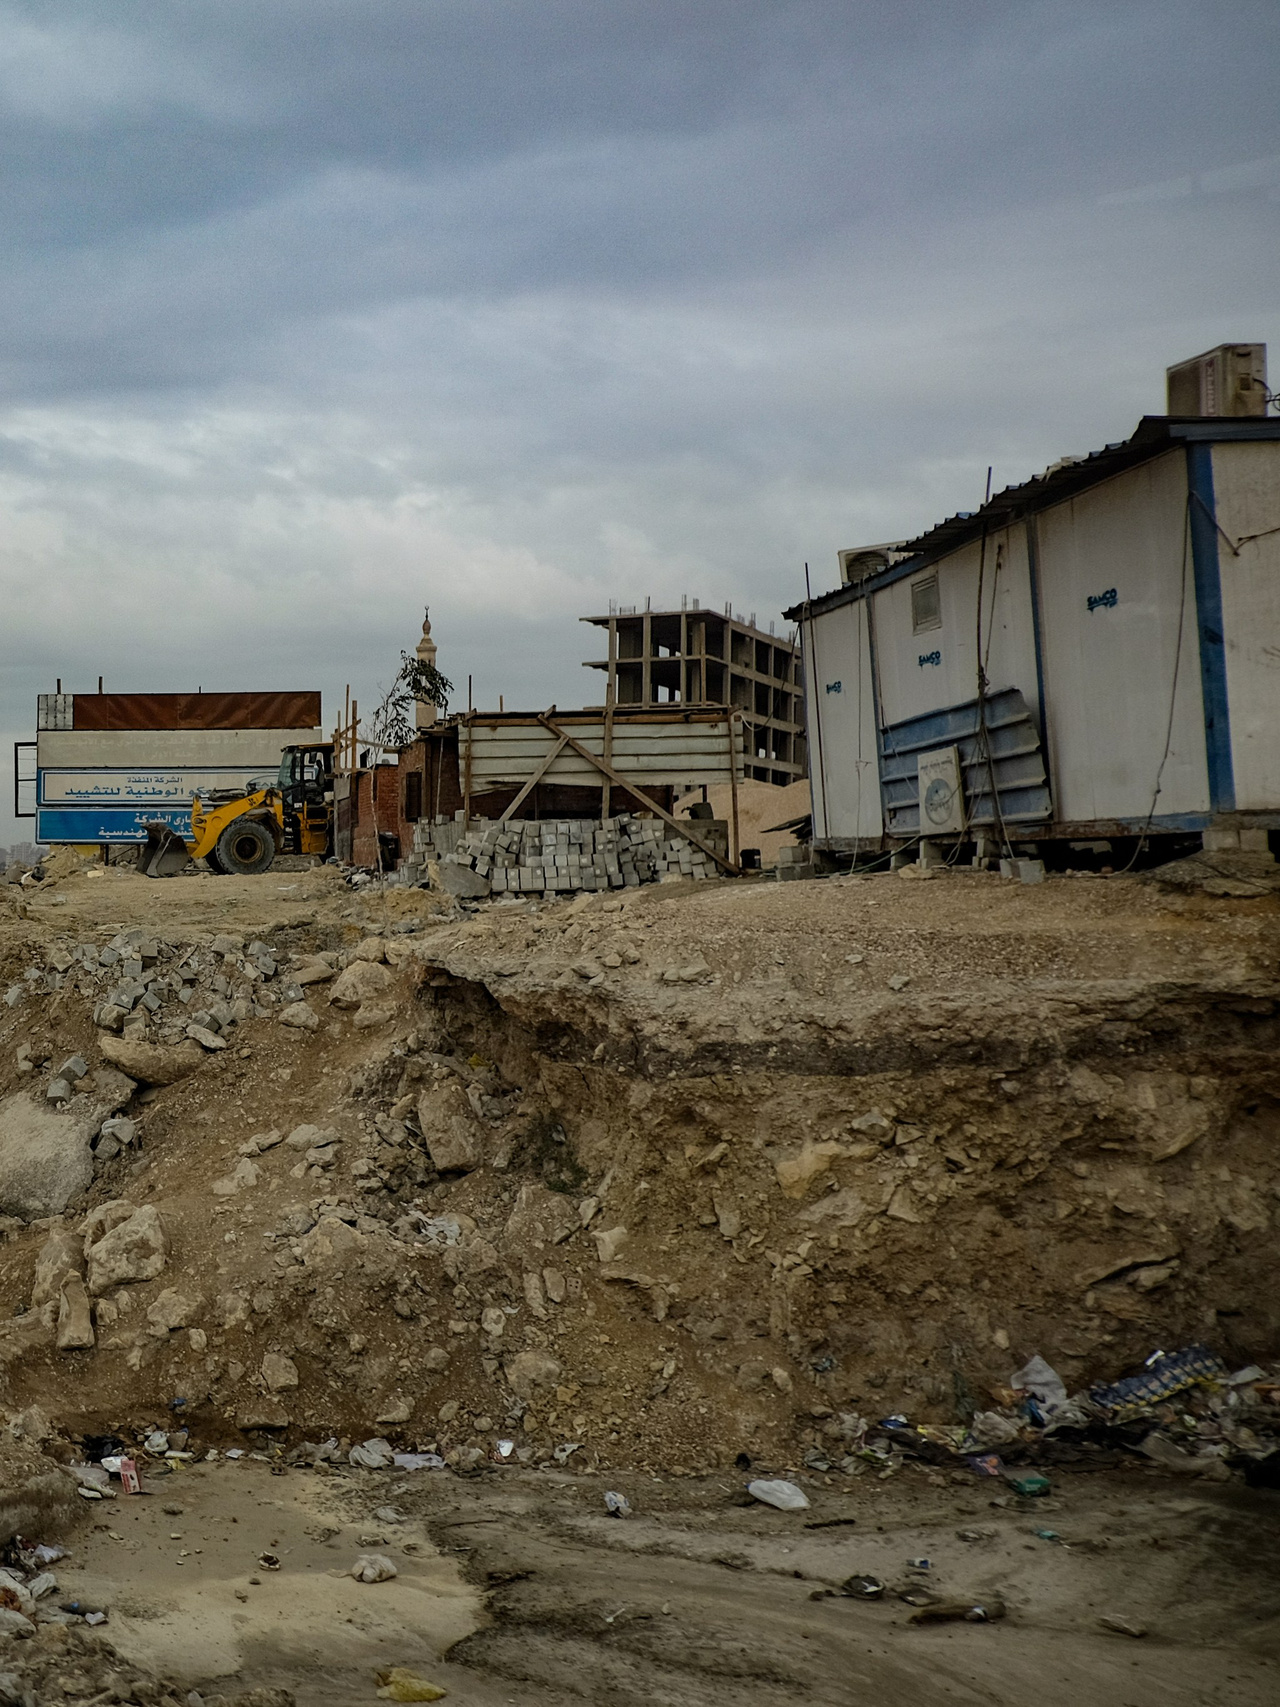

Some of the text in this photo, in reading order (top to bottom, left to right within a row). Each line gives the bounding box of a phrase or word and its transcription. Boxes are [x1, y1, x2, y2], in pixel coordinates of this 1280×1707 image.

[154, 776, 183, 785] الشركة
[64, 785, 121, 799] للتشييد
[125, 785, 184, 798] الوطنية
[134, 812, 172, 823] الشركة
